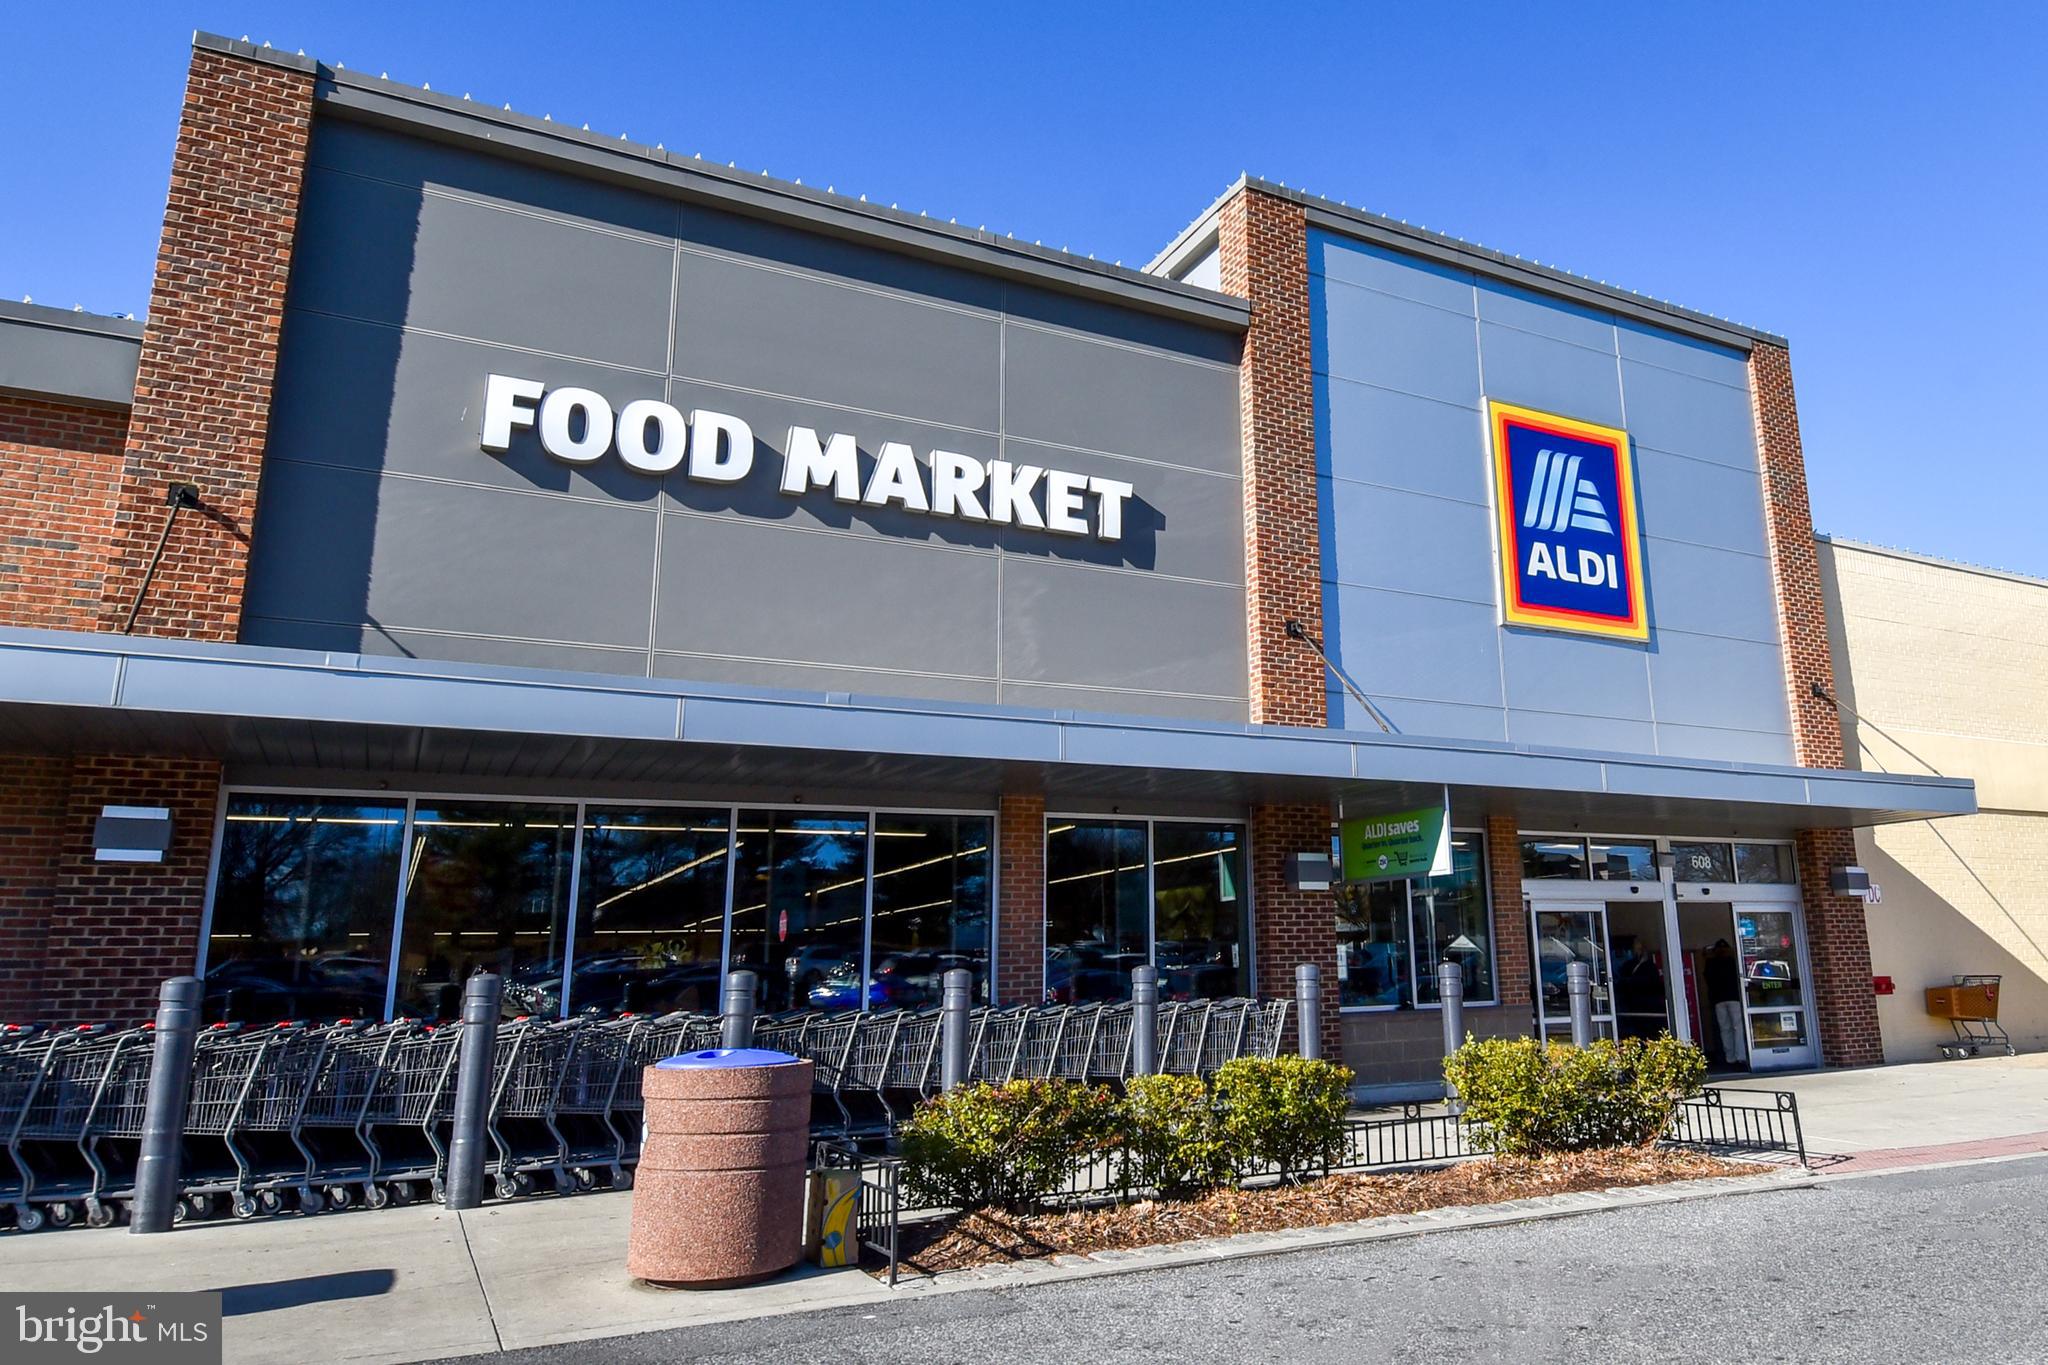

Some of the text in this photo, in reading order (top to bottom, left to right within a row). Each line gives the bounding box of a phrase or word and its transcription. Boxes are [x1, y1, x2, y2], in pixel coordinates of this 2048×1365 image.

[480, 373, 1134, 542] FOOD MARKET
[1527, 541, 1618, 589] ALDI
[1691, 855, 1712, 869] 608
